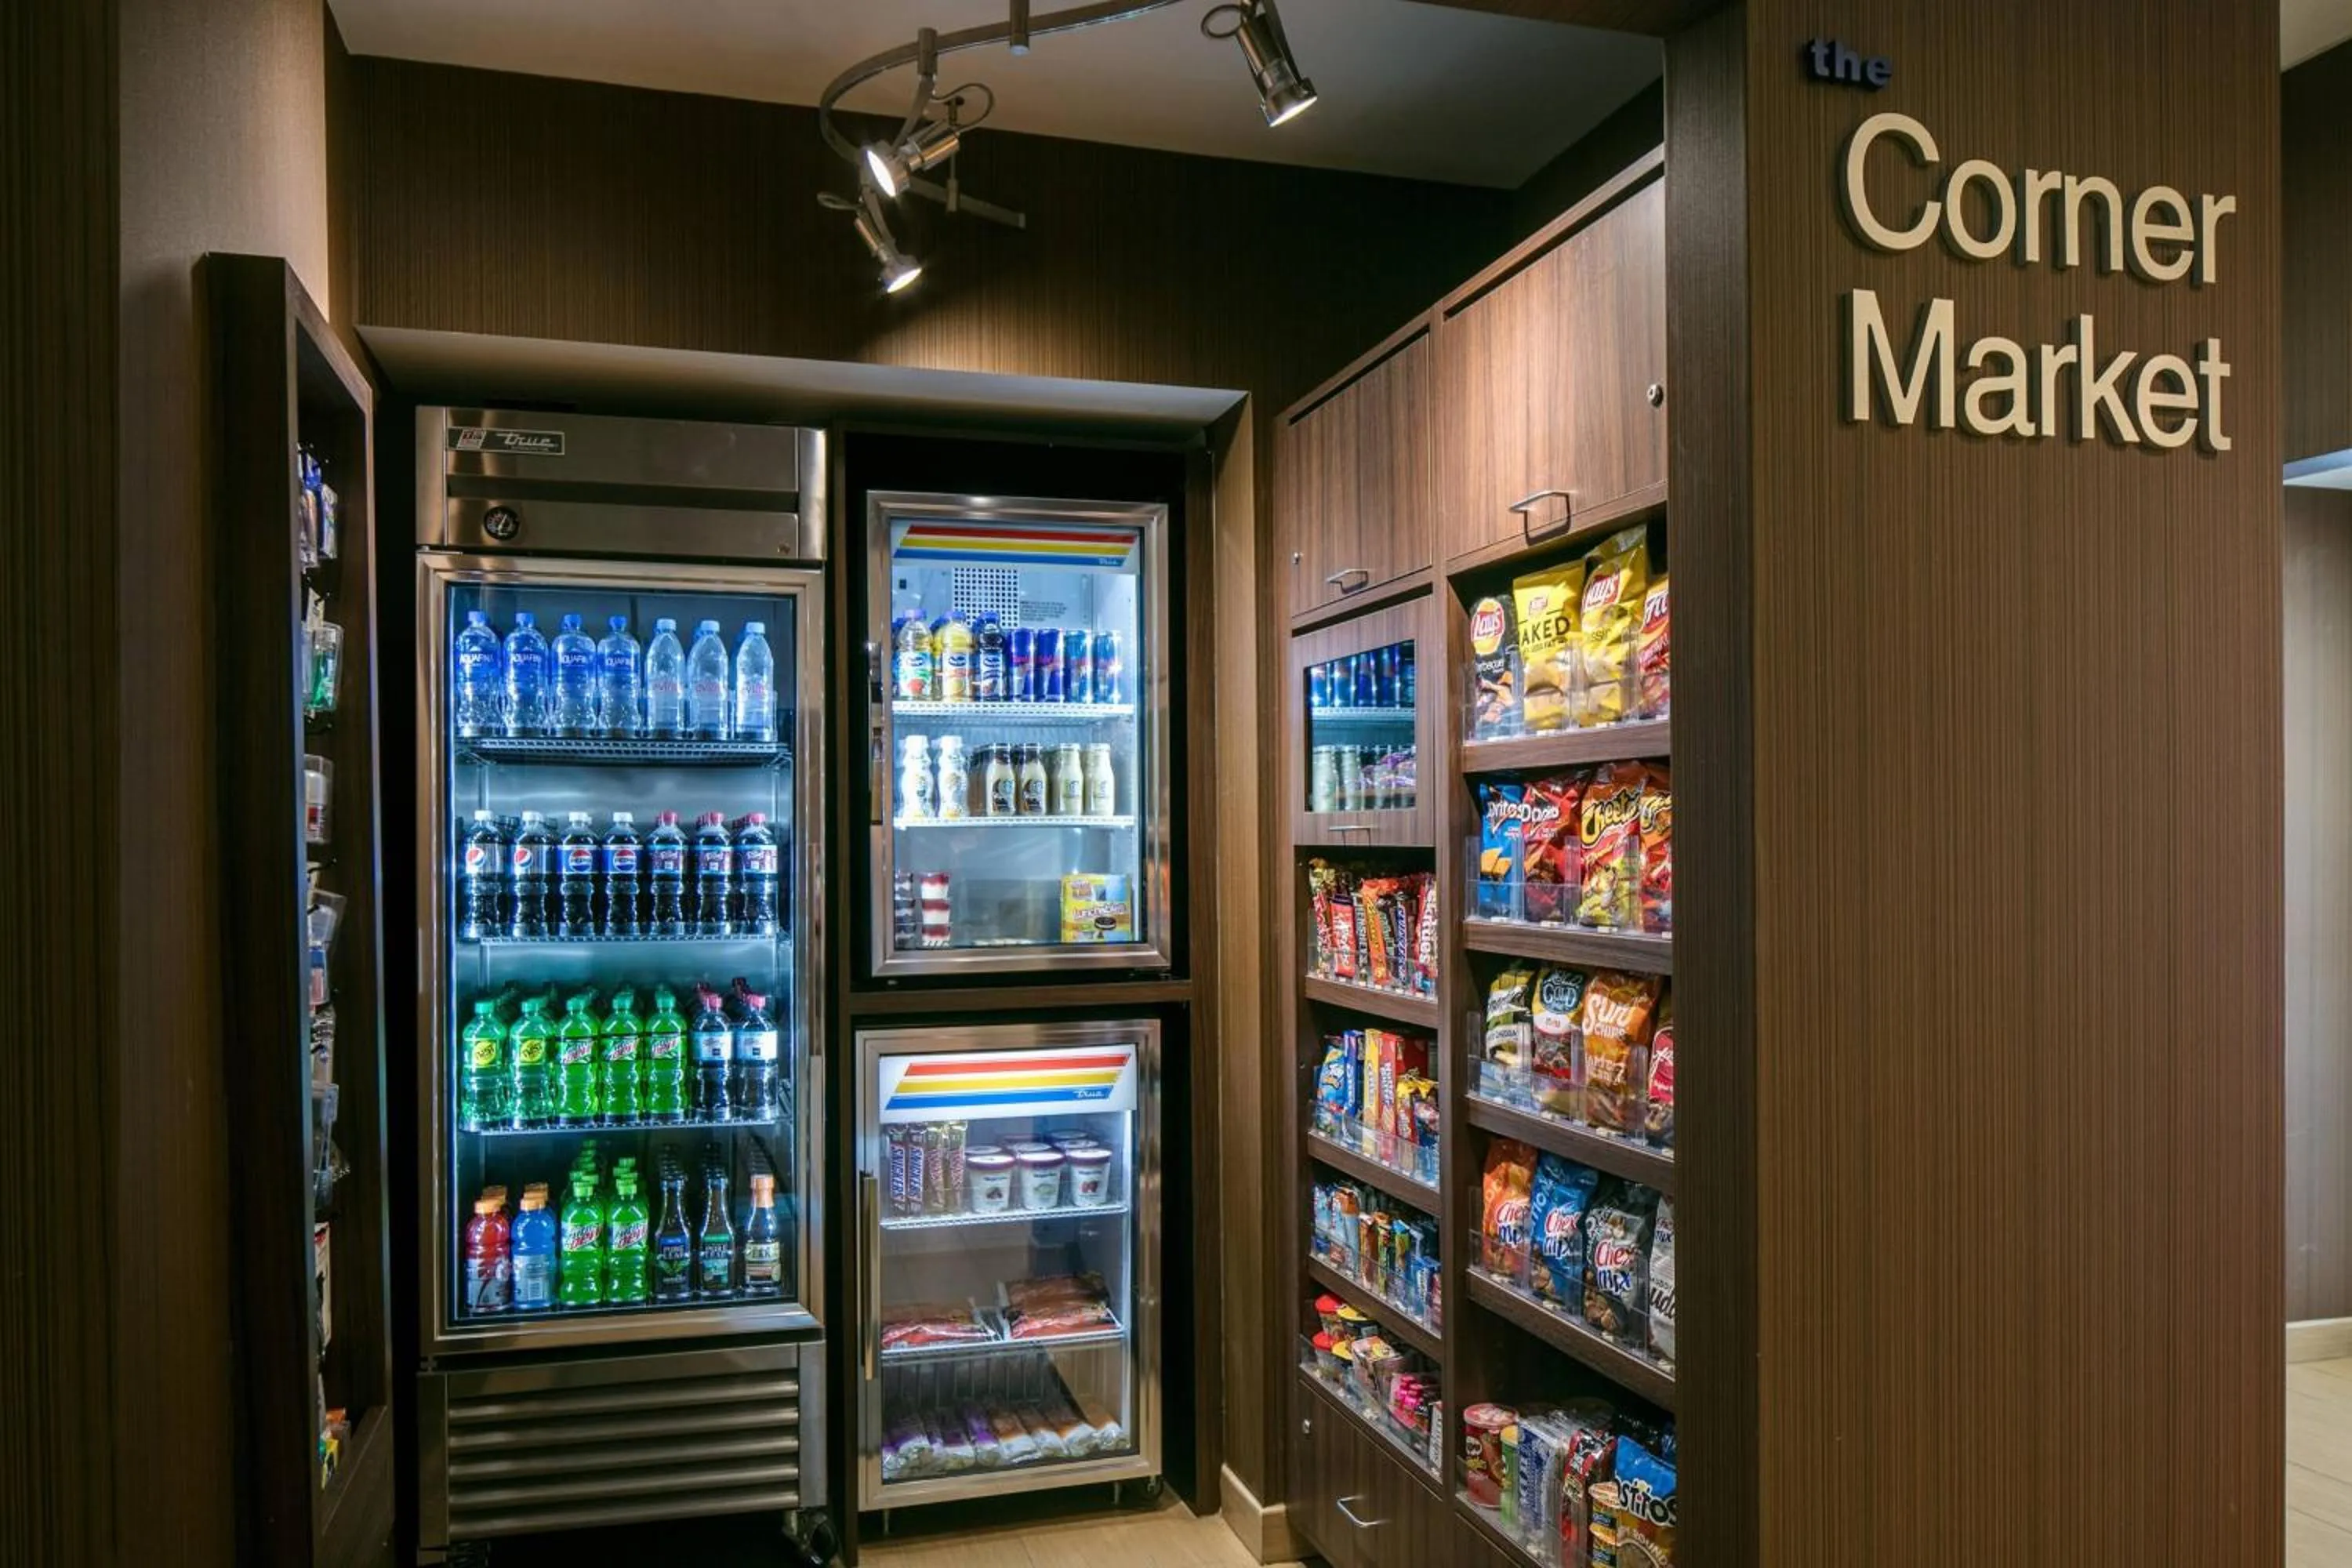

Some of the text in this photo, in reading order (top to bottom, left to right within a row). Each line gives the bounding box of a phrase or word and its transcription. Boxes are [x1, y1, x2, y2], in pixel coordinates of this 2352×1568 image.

[1810, 38, 1893, 86] the
[1846, 112, 2237, 284] Corner
[1852, 288, 2232, 452] Market
